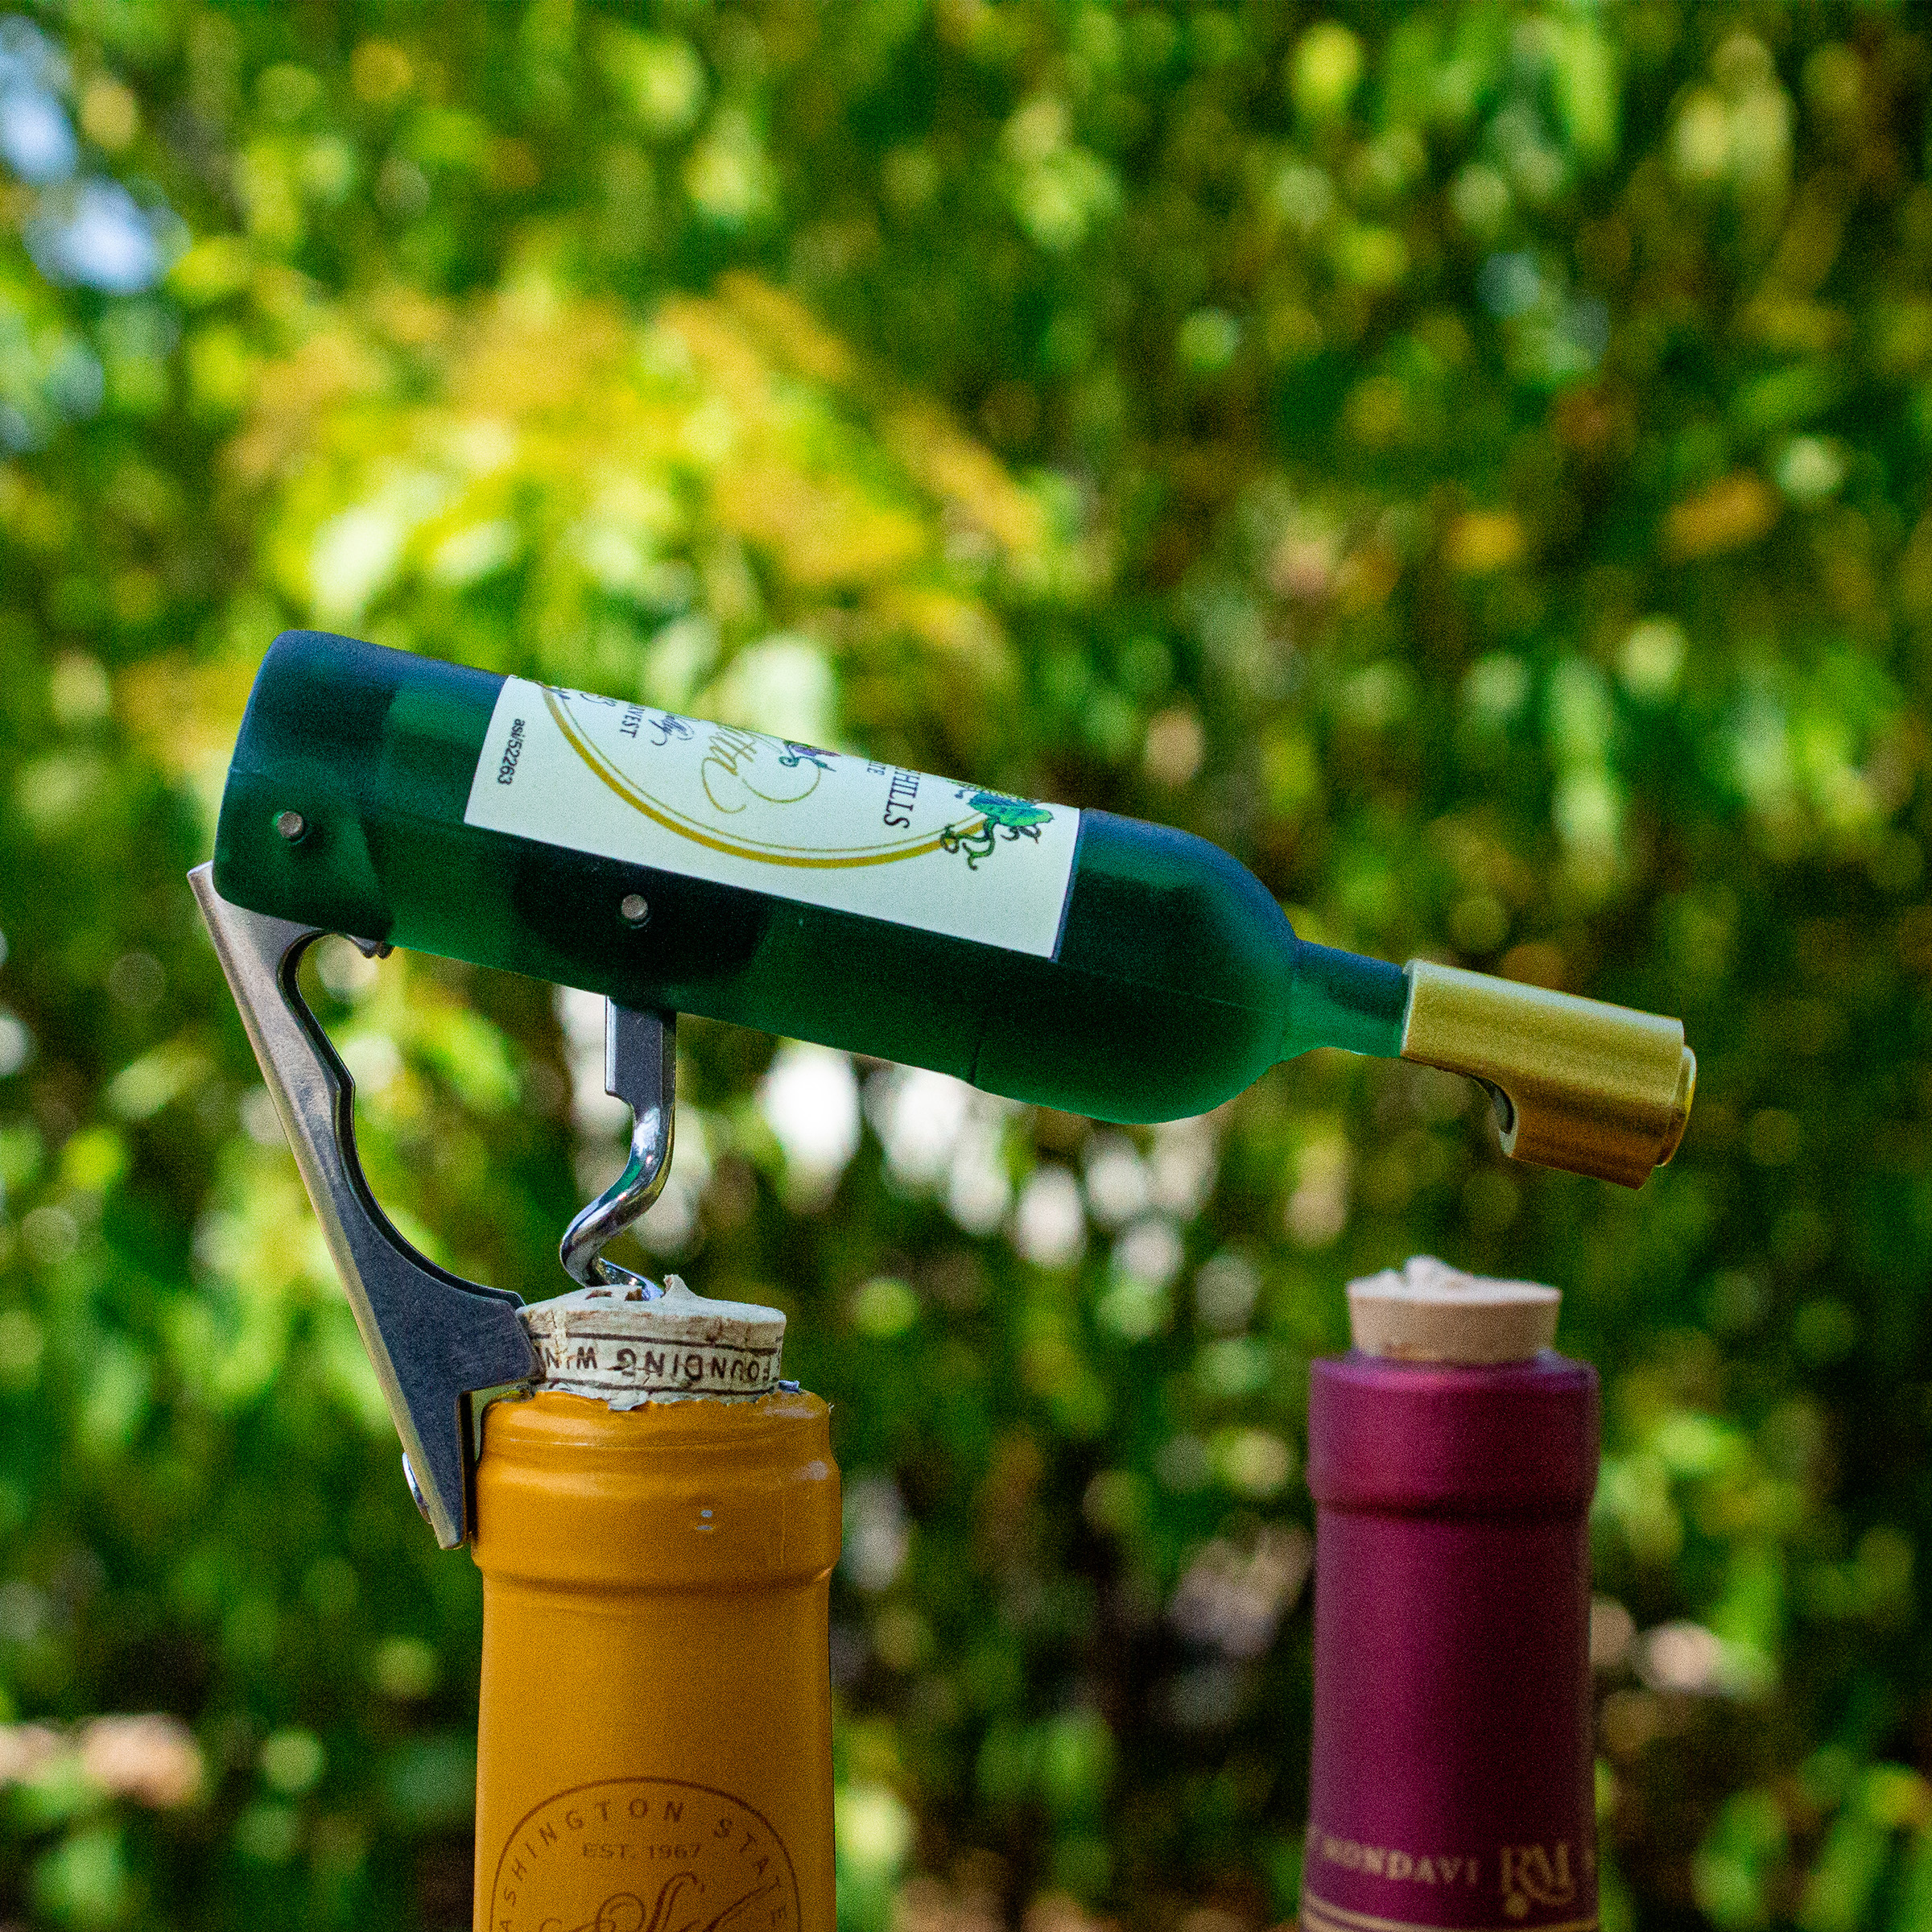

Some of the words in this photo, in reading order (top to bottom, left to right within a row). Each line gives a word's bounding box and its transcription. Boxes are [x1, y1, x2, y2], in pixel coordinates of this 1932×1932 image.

[497, 717, 527, 786] asi/52263
[616, 1348, 770, 1384] FOUNDING
[581, 1842, 635, 1860] EST.
[647, 1842, 703, 1860] 1967
[713, 1816, 788, 1927] STATE
